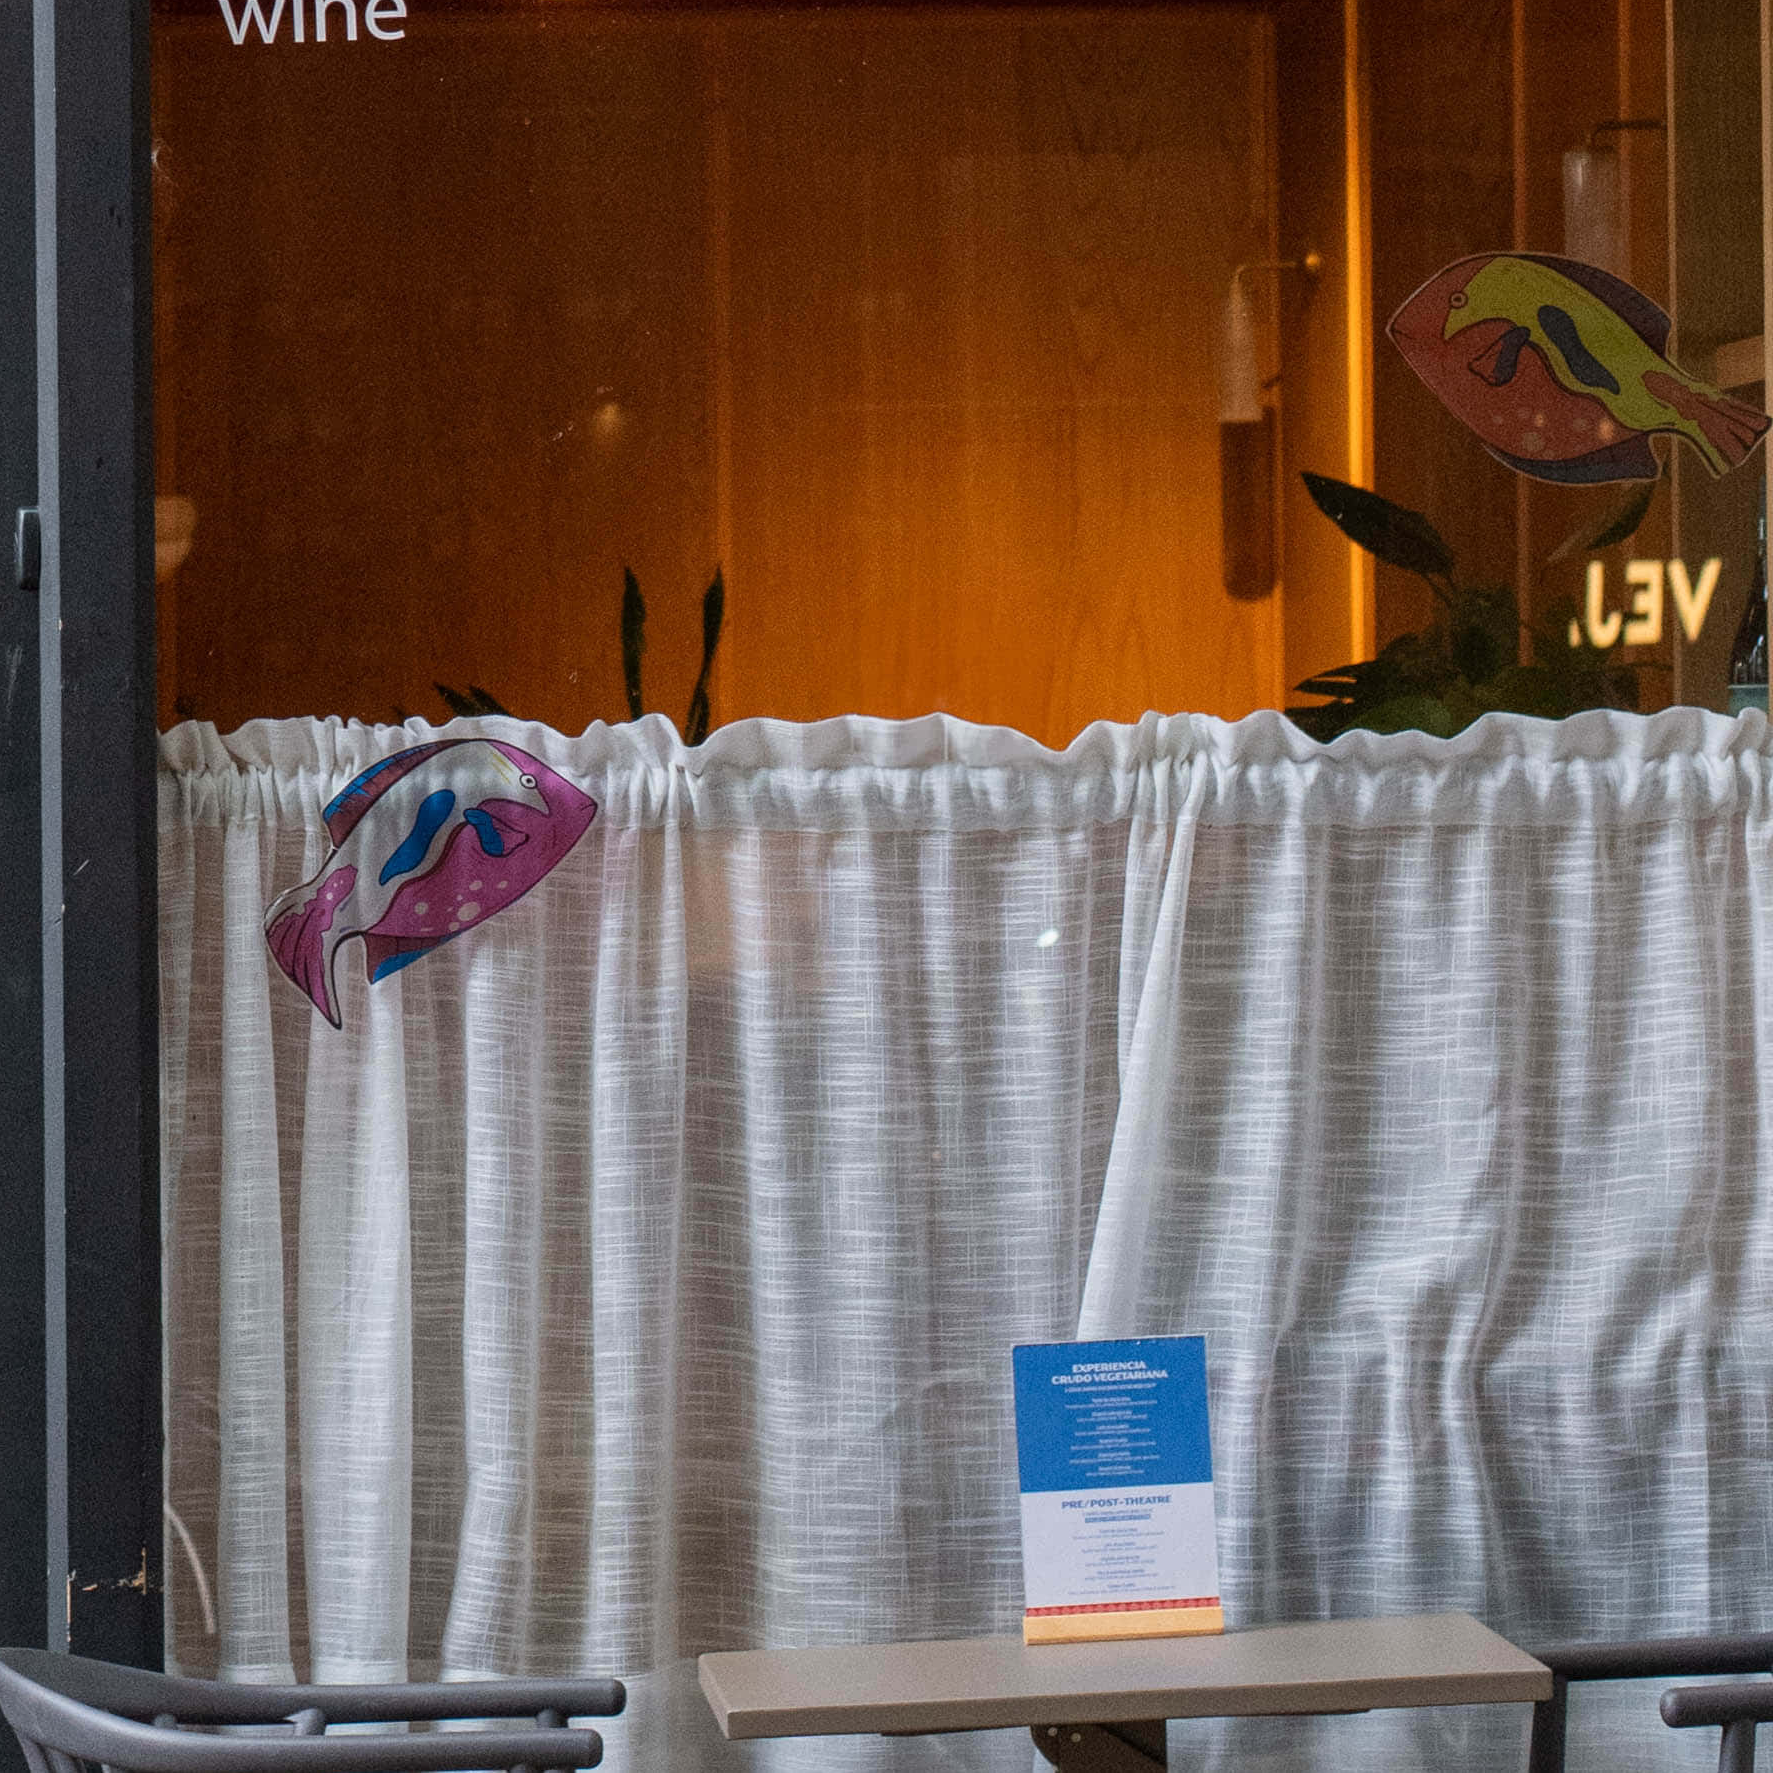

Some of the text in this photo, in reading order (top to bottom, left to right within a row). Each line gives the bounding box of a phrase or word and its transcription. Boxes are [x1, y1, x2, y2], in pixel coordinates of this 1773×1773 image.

[1071, 1360, 1147, 1374] EXPERIENCIA
[1051, 1369, 1169, 1386] CRUDO VEGETARIANA
